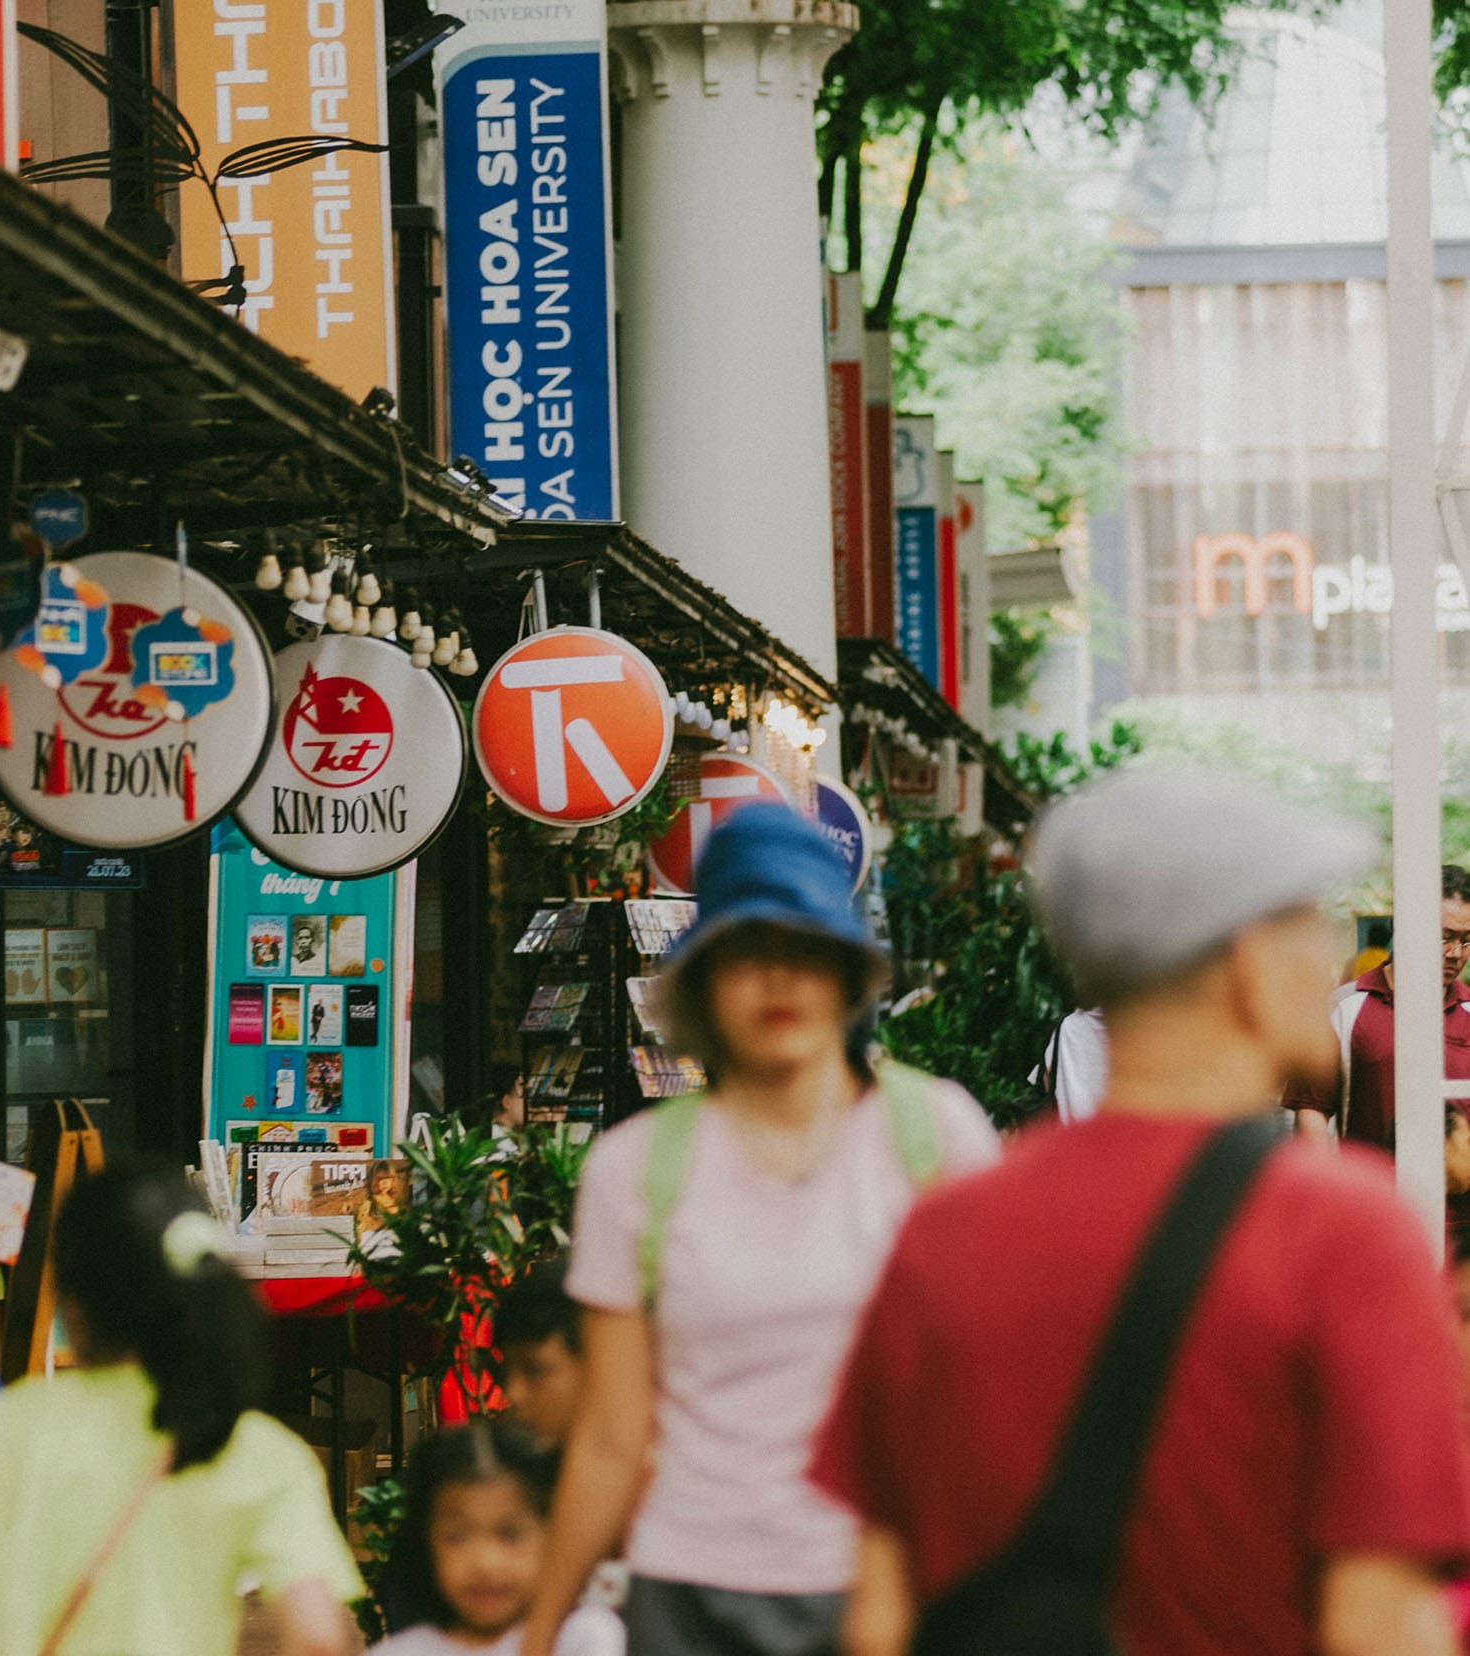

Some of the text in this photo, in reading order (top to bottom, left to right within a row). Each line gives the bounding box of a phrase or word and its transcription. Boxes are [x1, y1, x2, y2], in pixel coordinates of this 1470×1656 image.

[465, 5, 574, 23] UNIVERSITY
[476, 78, 517, 187] SEN
[529, 78, 572, 350] UNIVERSITY
[479, 199, 521, 324] HOA
[481, 339, 534, 461] HỌC
[536, 366, 574, 458] SEN
[272, 786, 324, 834] KIM
[260, 872, 324, 904] tháng
[320, 1164, 368, 1180] TIPPI
